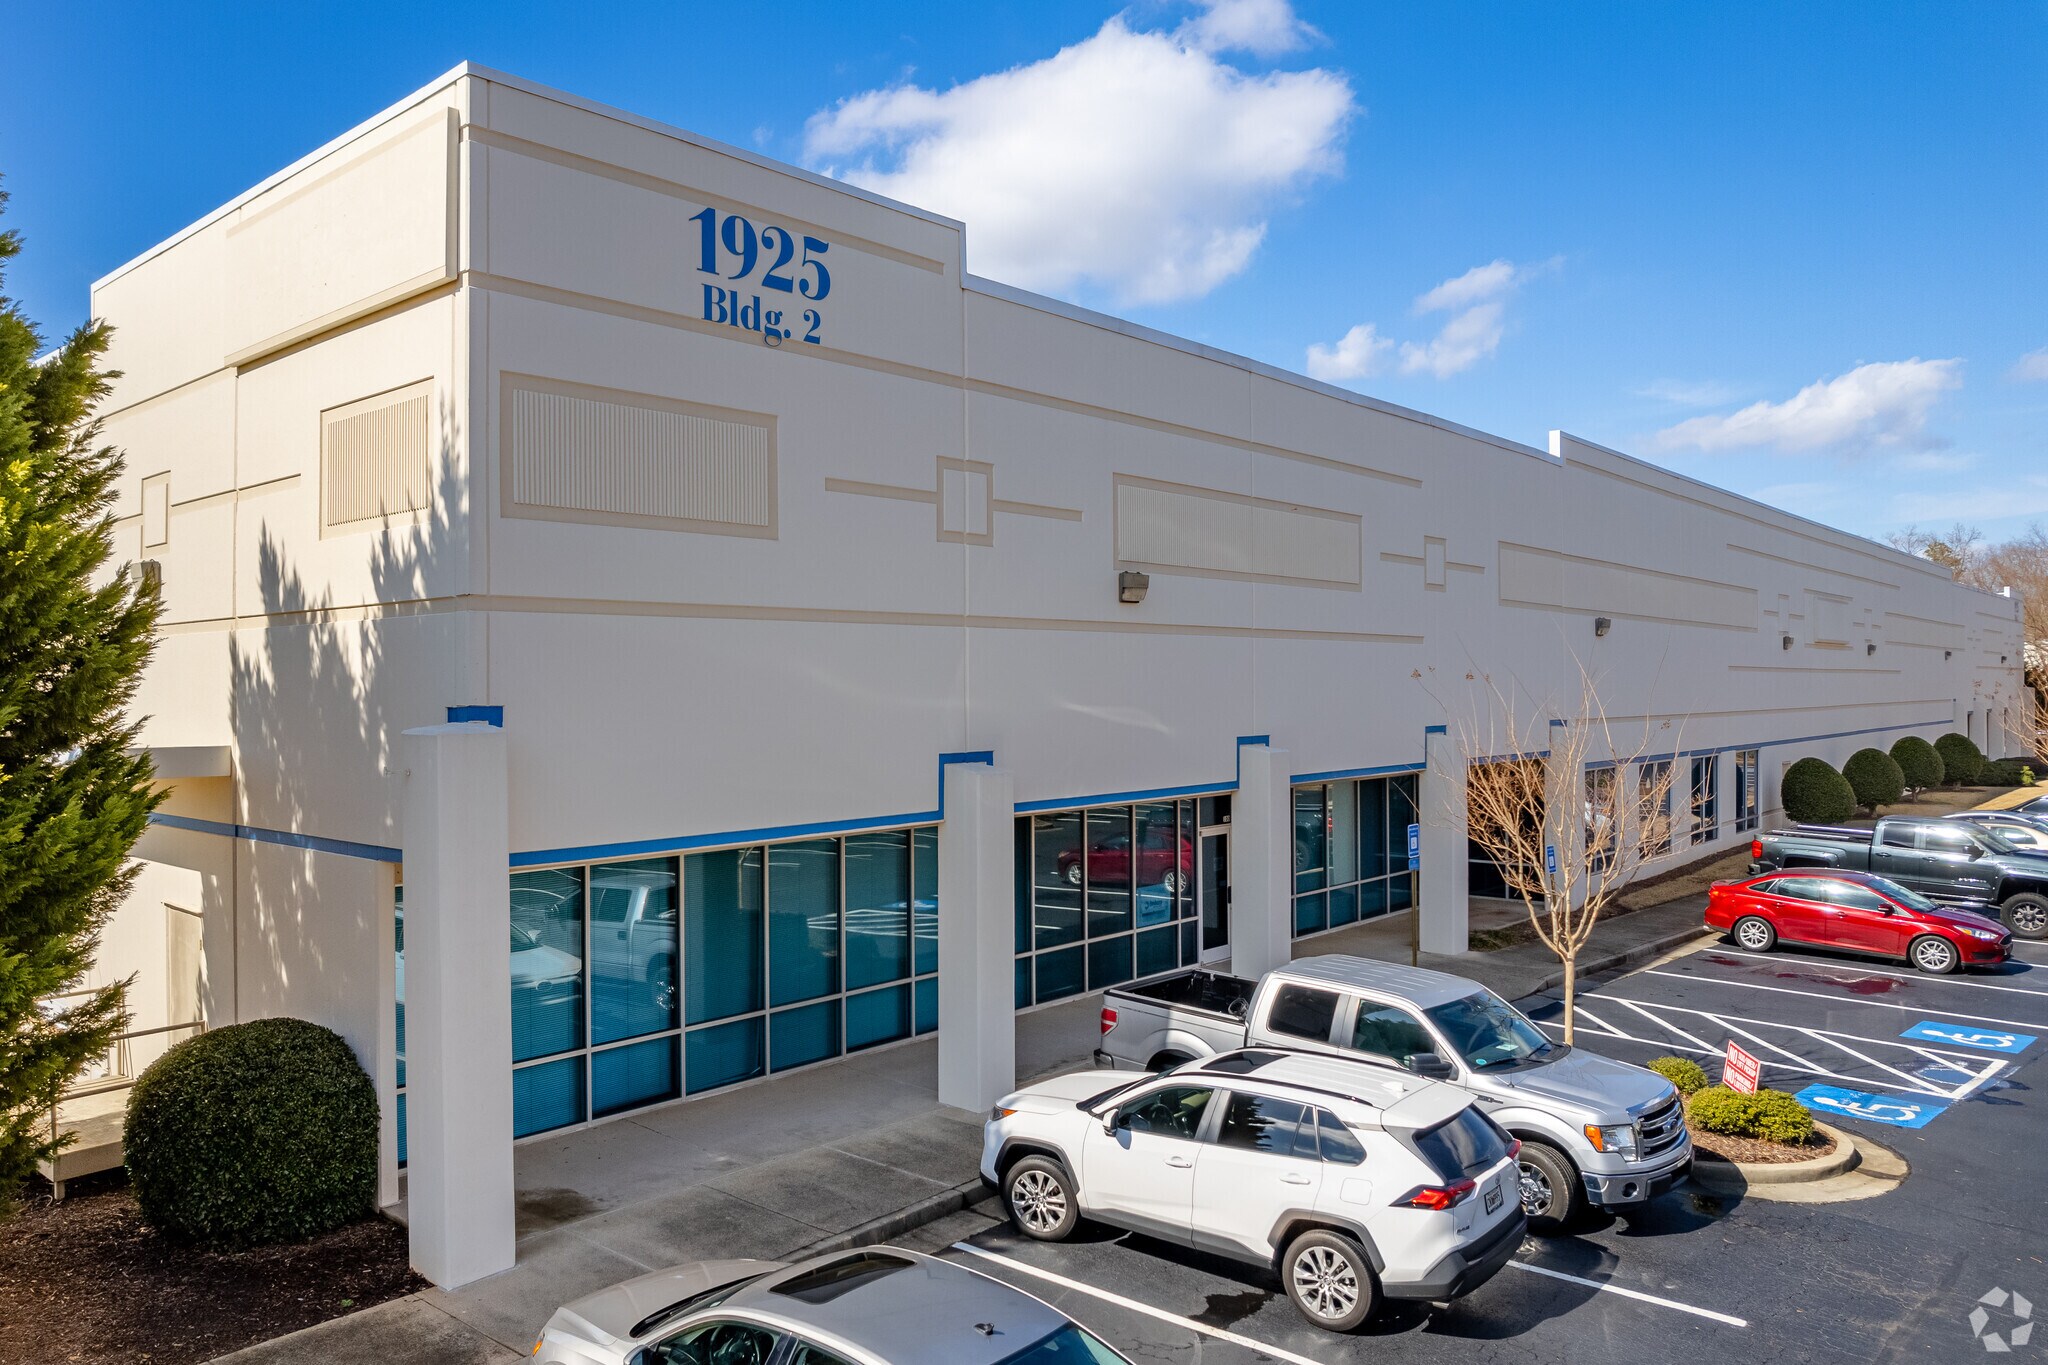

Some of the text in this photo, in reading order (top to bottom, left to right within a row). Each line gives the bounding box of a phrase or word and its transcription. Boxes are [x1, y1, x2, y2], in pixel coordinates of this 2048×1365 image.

[688, 207, 831, 301] 1925
[701, 283, 821, 347] Bldg. 2
[1725, 1065, 1735, 1084] NO
[1729, 1046, 1738, 1065] NO
